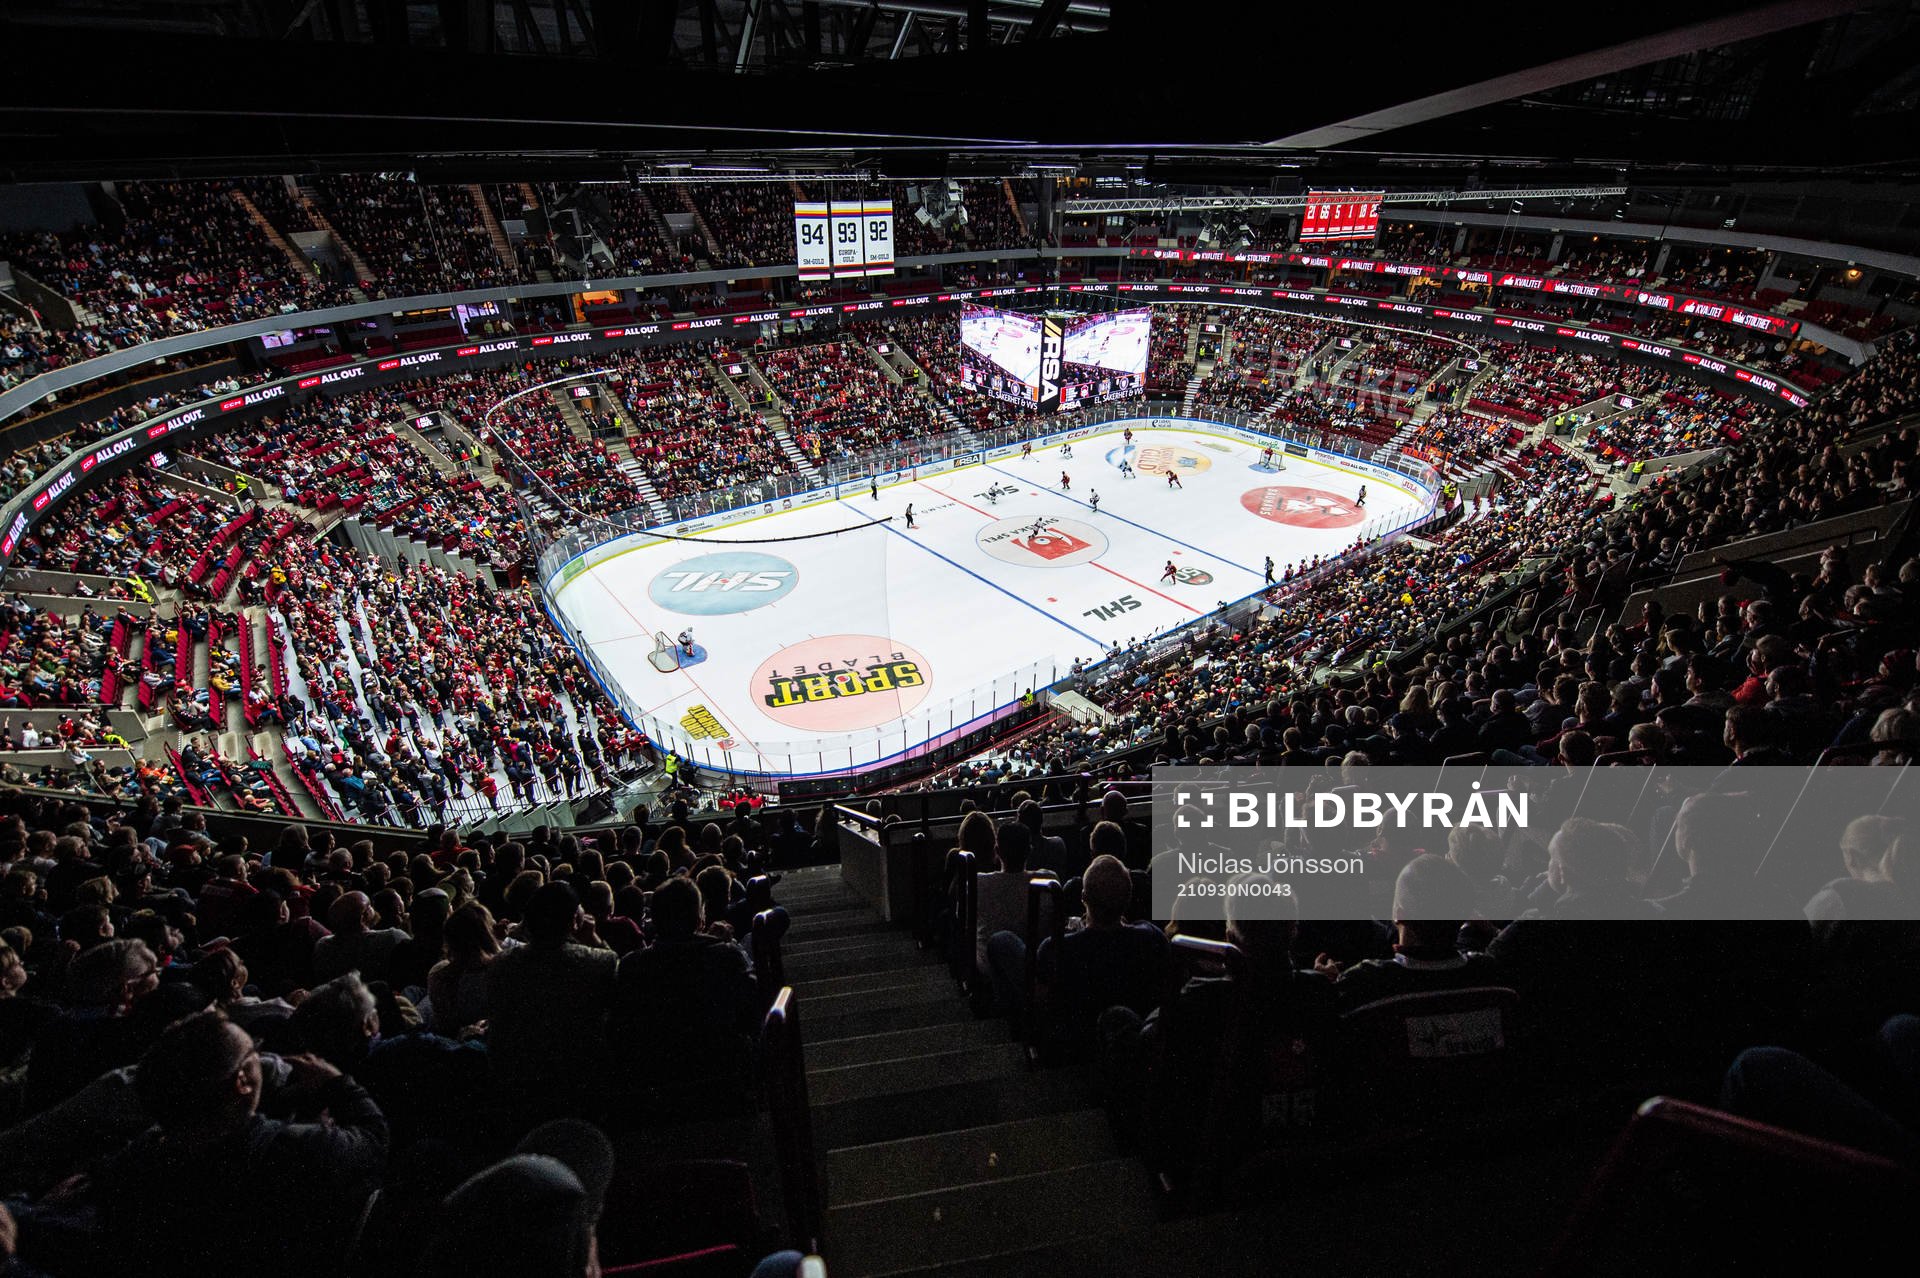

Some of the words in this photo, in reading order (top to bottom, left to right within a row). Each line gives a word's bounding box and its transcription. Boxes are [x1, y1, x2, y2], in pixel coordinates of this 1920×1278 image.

[1307, 205, 1316, 219] 21
[1320, 205, 1330, 219] 66
[1335, 205, 1341, 219] 5
[1348, 205, 1353, 218] 1
[802, 224, 823, 244] 94
[838, 223, 856, 243] 93
[870, 221, 887, 241] 92
[1514, 278, 1542, 288] KVALITET
[1569, 284, 1599, 296] STOLTHET
[950, 293, 962, 301] ALL
[1339, 297, 1354, 305] ALL
[805, 308, 819, 316] ALL
[857, 303, 871, 311] ALL
[1393, 304, 1408, 312] ALL
[1696, 304, 1723, 318] KVALITET
[750, 314, 765, 322] ALL
[1450, 312, 1467, 320] ALL
[690, 321, 706, 329] ALL
[1512, 320, 1529, 329] ALL
[1744, 315, 1771, 330] STOLTHET
[624, 327, 641, 336] ALL
[1574, 331, 1592, 340] ALL
[553, 335, 571, 344] ALL
[479, 344, 497, 354] ALL
[1638, 343, 1654, 353] ALL
[400, 356, 419, 367] ALL
[1699, 358, 1713, 369] ALL
[1041, 337, 1061, 402] RSA
[321, 373, 340, 384] ALL
[1750, 375, 1764, 386] ALL
[244, 393, 263, 405] ALL
[1790, 394, 1801, 406] ALL
[167, 418, 184, 431] ALL
[1067, 430, 1089, 439] CCM
[96, 446, 115, 463] ALL
[960, 455, 979, 465] RSA
[1402, 480, 1418, 492] JULA
[48, 486, 61, 500] ALL
[9, 525, 21, 544] ALL
[981, 531, 1010, 544] SPEL
[664, 572, 792, 592] SHL
[1083, 595, 1142, 622] SHL
[769, 652, 904, 678] BLADET
[765, 660, 924, 708] SPORT
